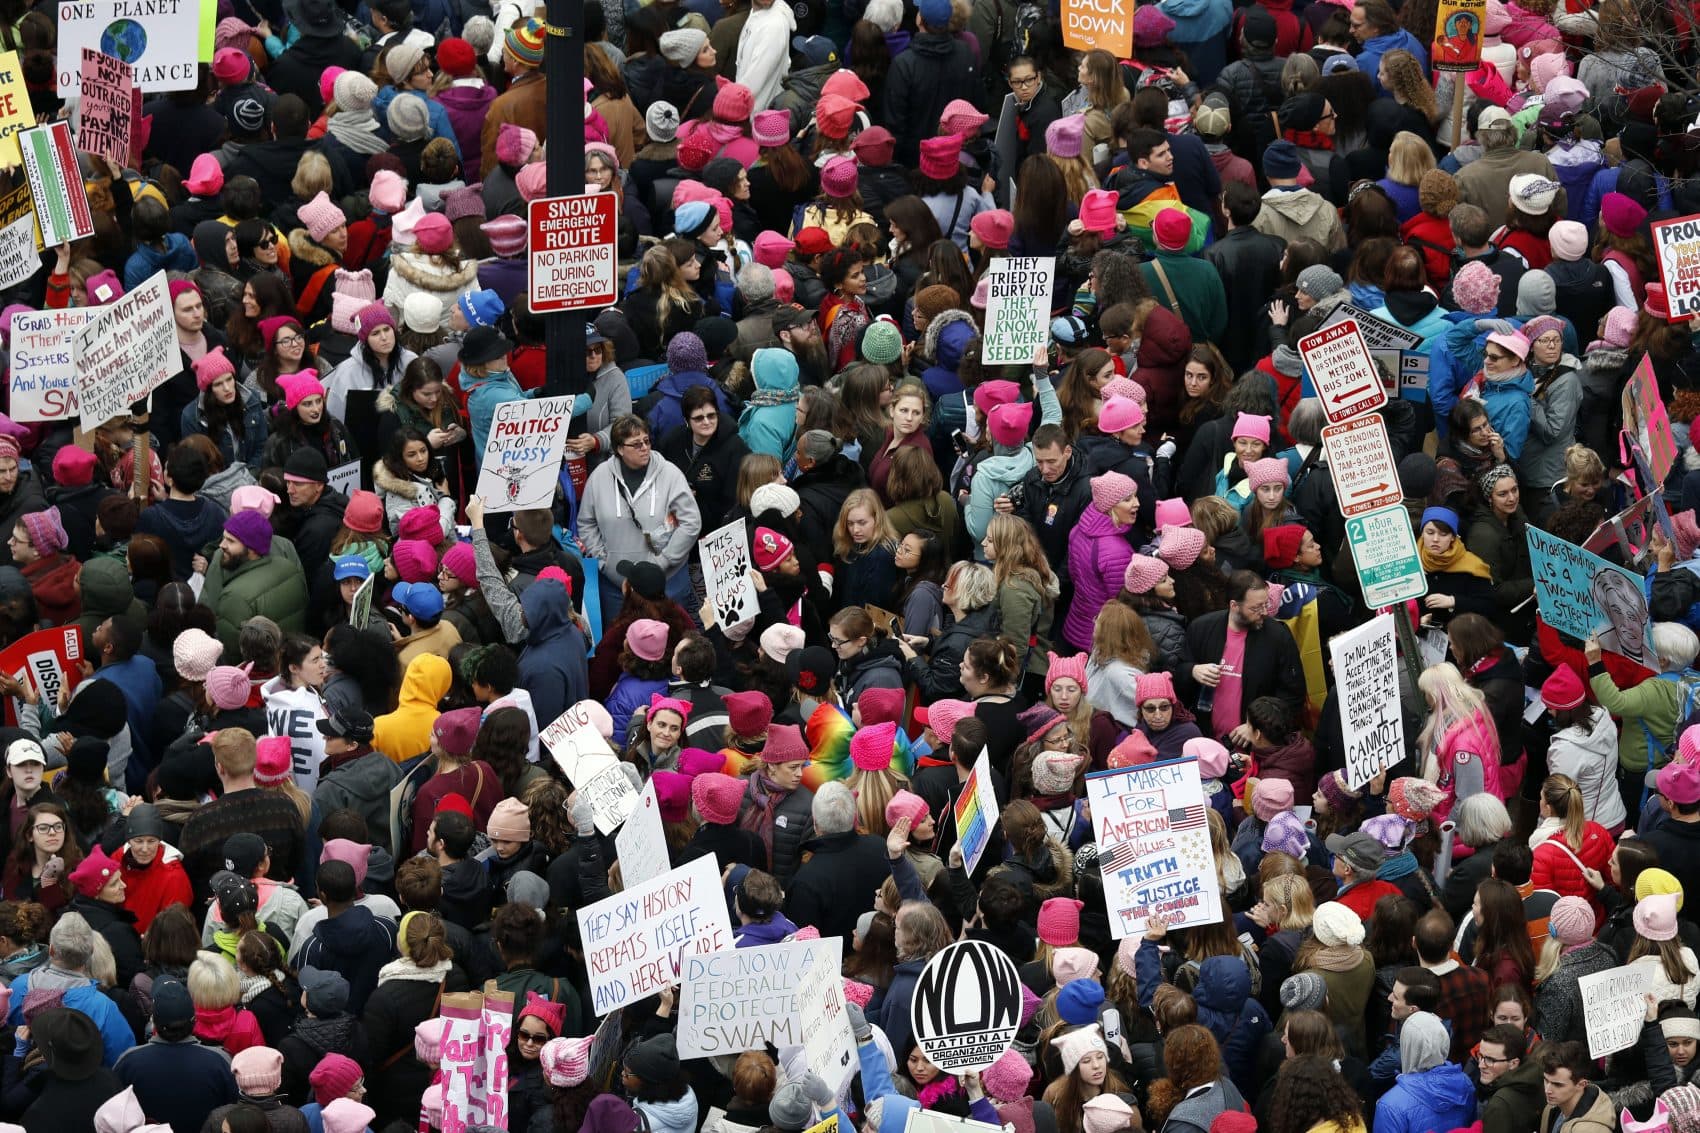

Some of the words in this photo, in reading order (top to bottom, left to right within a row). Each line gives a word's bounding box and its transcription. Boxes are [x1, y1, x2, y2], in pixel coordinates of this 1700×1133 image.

[61, 4, 94, 21] ONE
[113, 0, 180, 17] PLANET
[1069, 13, 1124, 36] DOWN
[83, 48, 95, 62] IF
[97, 54, 131, 78] YOU'RE
[98, 66, 122, 86] NOT
[82, 82, 130, 113] OUTRAGED
[82, 115, 129, 144] PAYING
[79, 129, 128, 168] ATTENTION
[548, 198, 598, 218] SNOW
[540, 214, 606, 231] EMERGENCY
[18, 231, 29, 245] ARE
[546, 228, 600, 248] ROUTE
[538, 254, 555, 267] NO
[560, 247, 608, 264] PARKING
[1006, 258, 1038, 270] THEY
[552, 265, 595, 281] DURING
[990, 272, 1027, 284] TRIED
[1030, 272, 1047, 283] TO
[538, 279, 608, 299] EMERGENCY
[992, 285, 1026, 297] BURY
[1030, 285, 1048, 296] US.
[997, 309, 1038, 320] DIDN'T
[1002, 297, 1035, 309] THEY
[80, 328, 94, 352] I
[98, 313, 114, 338] AM
[114, 300, 134, 325] NOT
[134, 285, 160, 314] FREE
[996, 320, 1038, 332] KNOW
[1341, 306, 1355, 316] NO
[1355, 312, 1416, 343] COMPROMISE
[77, 342, 114, 374] WHILE
[113, 328, 133, 351] ANY
[131, 305, 164, 336] WOMAN
[985, 333, 1003, 346] WE
[1011, 331, 1044, 344] WERE
[1306, 336, 1323, 349] TOW
[1326, 325, 1348, 340] AWAY
[1312, 351, 1322, 360] NO
[1324, 337, 1355, 356] PARKING
[1376, 332, 1394, 343] THE
[80, 375, 95, 392] IS
[96, 350, 134, 379] UNFREE,
[133, 336, 153, 358] EVEN
[153, 319, 174, 342] WHEN
[987, 345, 1034, 361] SEEDS!
[1324, 346, 1361, 368] STANDING
[1405, 359, 1418, 367] IS
[81, 386, 104, 403] HER
[104, 361, 143, 389] SHACKLES
[142, 350, 154, 364] ARE
[155, 333, 174, 354] VERY
[1328, 361, 1356, 378] METRO
[12, 374, 36, 392] And
[84, 376, 135, 416] DIFFERENT
[138, 366, 155, 385] FROM
[156, 350, 168, 369] MY
[147, 367, 168, 393] LORDE
[1323, 380, 1342, 392] BUS
[1345, 368, 1368, 384] ZONE
[497, 403, 527, 422] GET
[538, 400, 572, 418] YOUR
[1332, 413, 1338, 421] IF
[1340, 406, 1358, 418] TOWED
[1358, 400, 1371, 410] CALL
[496, 416, 562, 439] POLITICS
[1328, 424, 1348, 435] TOW
[1352, 417, 1375, 428] AWAY
[488, 438, 512, 453] OUT
[514, 436, 532, 448] OF
[536, 434, 555, 447] MY
[1330, 440, 1341, 449] NO
[1344, 428, 1380, 445] STANDING
[1335, 450, 1346, 460] OR
[1349, 440, 1382, 456] PARKING
[502, 447, 551, 464] PUSSY
[1338, 451, 1384, 472] 7AM-9:30AM
[332, 468, 358, 481] Politics
[1341, 462, 1389, 482] 4PM-6:30PM
[1351, 523, 1363, 540] 2
[1368, 518, 1392, 531] HOUR
[1371, 525, 1403, 538] PARKING
[705, 532, 732, 558] THIS
[712, 544, 743, 571] PUSSY
[716, 569, 735, 589] HAS
[716, 580, 746, 607] CLAWS
[66, 632, 78, 657] ACLU
[1355, 644, 1366, 658] NO
[1368, 632, 1391, 654] LONGER
[1346, 655, 1380, 680] ACCEPTING
[1383, 648, 1392, 660] THE
[1346, 676, 1366, 692] THINGS
[1373, 658, 1394, 678] CANNOT
[1347, 687, 1372, 707] CHANGE
[1374, 678, 1381, 693] I
[1383, 672, 1394, 687] AM
[1349, 694, 1380, 720] CHANGING
[1383, 687, 1396, 701] THE
[268, 709, 314, 738] WE
[540, 703, 588, 750] WARNING
[1351, 714, 1372, 733] THINGS
[1375, 703, 1388, 729] I
[1350, 718, 1399, 765] CANNOT
[1354, 738, 1401, 787] ACCEPT
[1099, 777, 1117, 799] I
[1127, 765, 1184, 792] MARCH
[604, 802, 629, 825] USE
[1125, 796, 1164, 813] FOR
[1101, 816, 1170, 846] AMERICAN
[1129, 836, 1176, 857] VALUES
[1118, 856, 1179, 886] TRUTH
[1137, 877, 1201, 905] JUSTICE
[584, 911, 611, 943] THEY
[616, 900, 639, 931] SAY
[643, 877, 692, 920] HISTORY
[1121, 905, 1150, 921] THE
[1155, 896, 1199, 914] COMMON
[590, 932, 647, 976] REPEATS
[738, 952, 791, 975] NOW
[802, 948, 814, 968] A
[595, 979, 625, 1011] AND
[630, 956, 668, 996] HERE
[695, 929, 724, 954] ARE
[915, 942, 1020, 1038] NOW
[693, 994, 800, 1024] PROTECTE
[700, 1017, 803, 1051] SWAM
[925, 1032, 1011, 1050] NATIONAL
[933, 1044, 1004, 1059] ORGANIZATION
[961, 1055, 993, 1064] WOMEN
